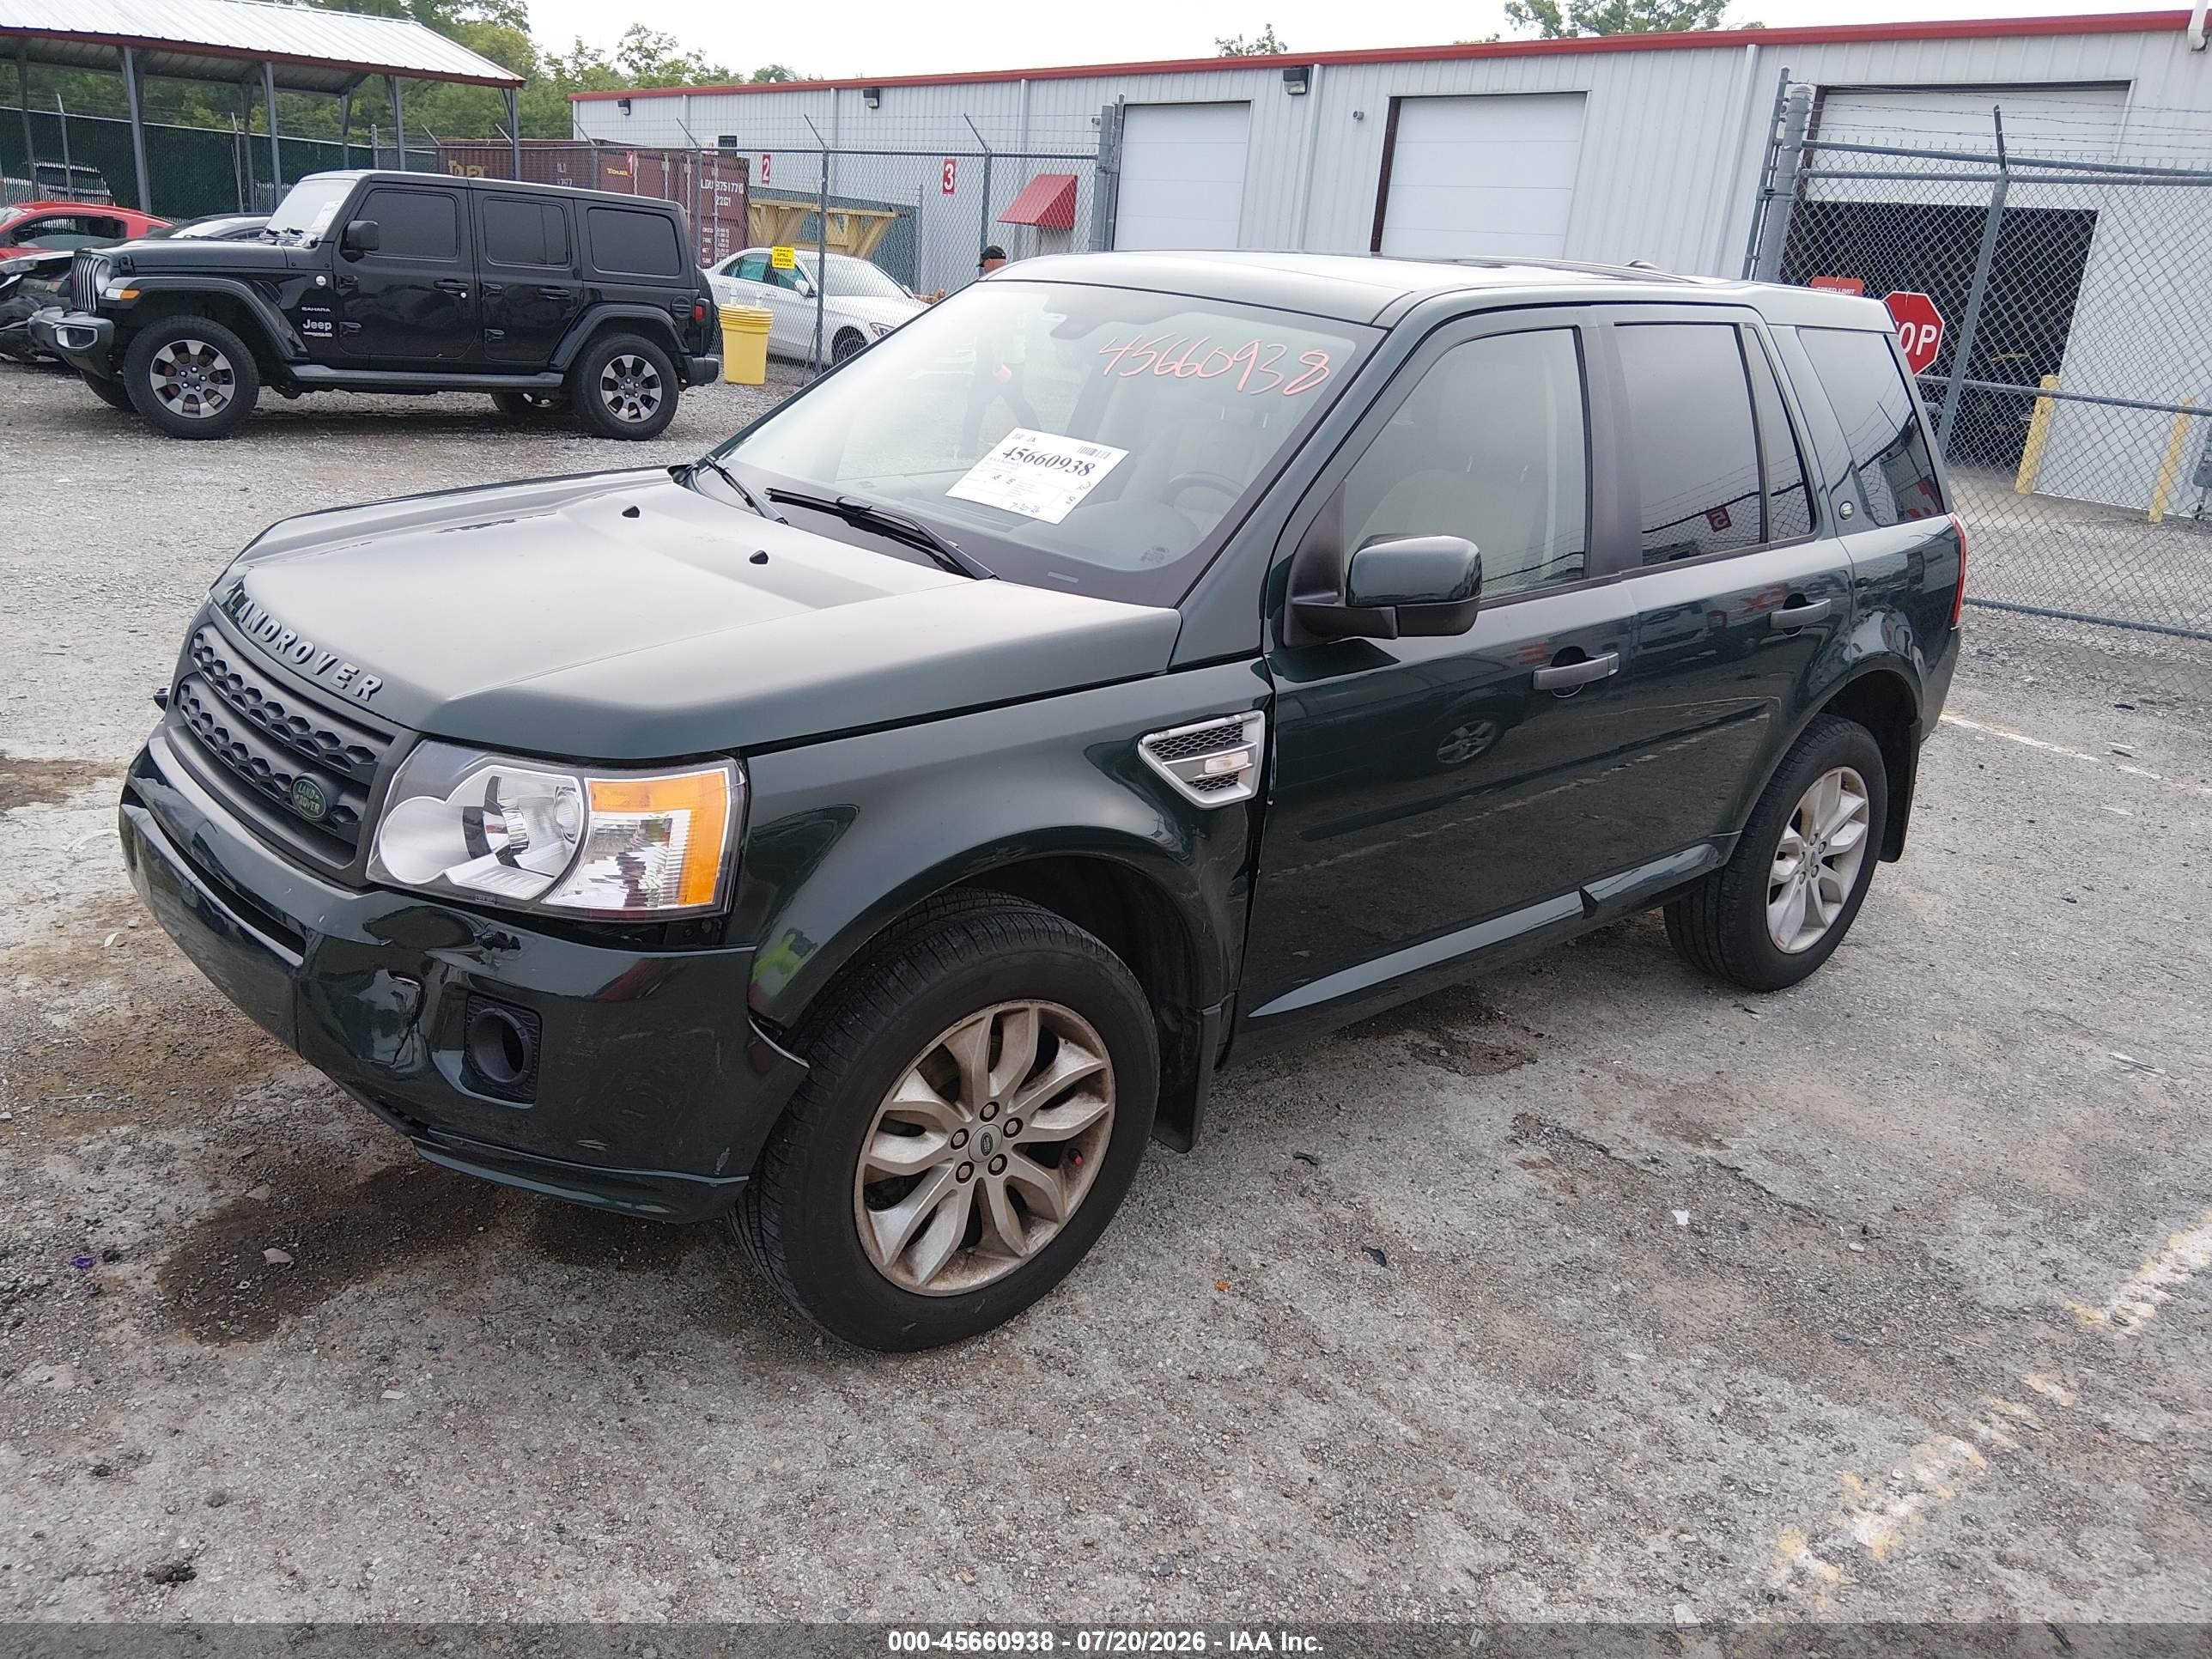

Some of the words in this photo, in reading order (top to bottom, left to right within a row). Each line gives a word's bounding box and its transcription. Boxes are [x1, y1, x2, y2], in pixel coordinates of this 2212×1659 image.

[763, 158, 770, 181] 2
[944, 163, 954, 191] 3
[302, 319, 332, 331] Jeep
[1895, 321, 1938, 356] OP
[1098, 331, 1331, 396] 45660938
[1002, 446, 1097, 477] 45660938
